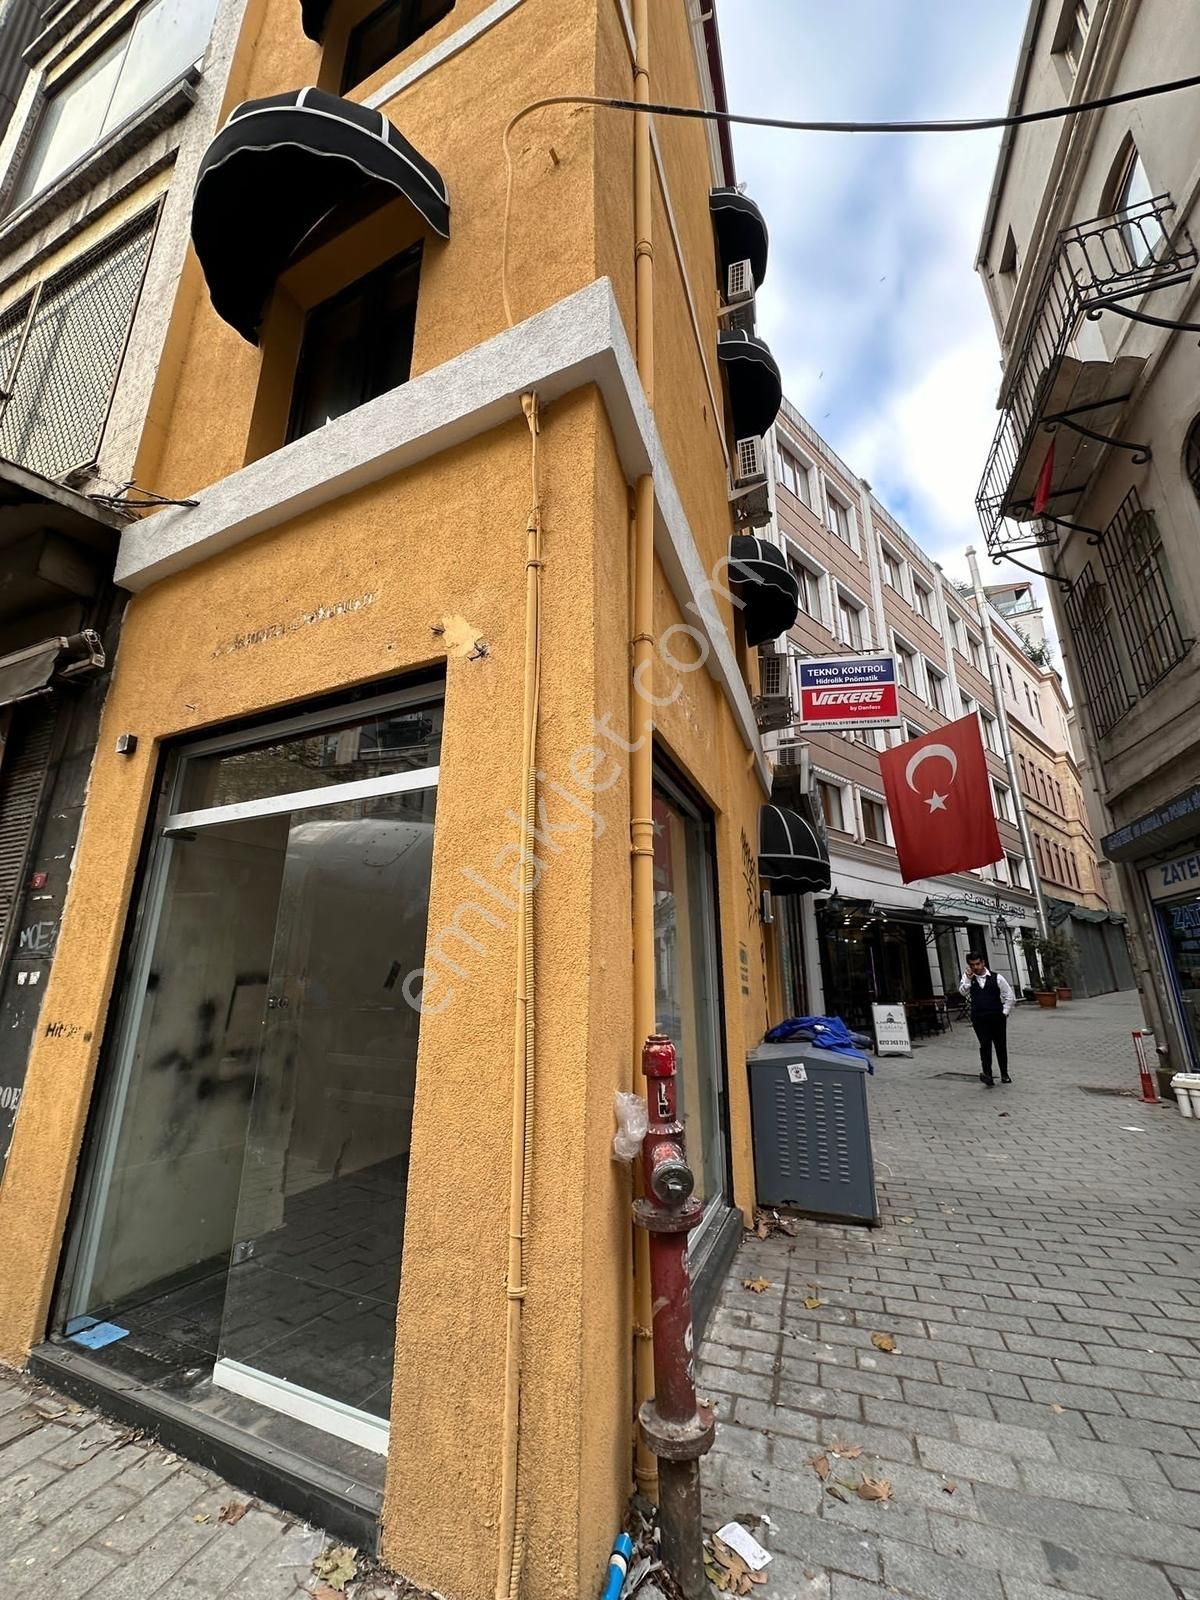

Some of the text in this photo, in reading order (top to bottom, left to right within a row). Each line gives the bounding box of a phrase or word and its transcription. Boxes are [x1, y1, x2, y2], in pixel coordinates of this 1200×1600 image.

[807, 664, 887, 677] TEKNO KONTROL
[815, 675, 879, 685] Hidrolik Pnömatik
[812, 688, 884, 705] VICKERS
